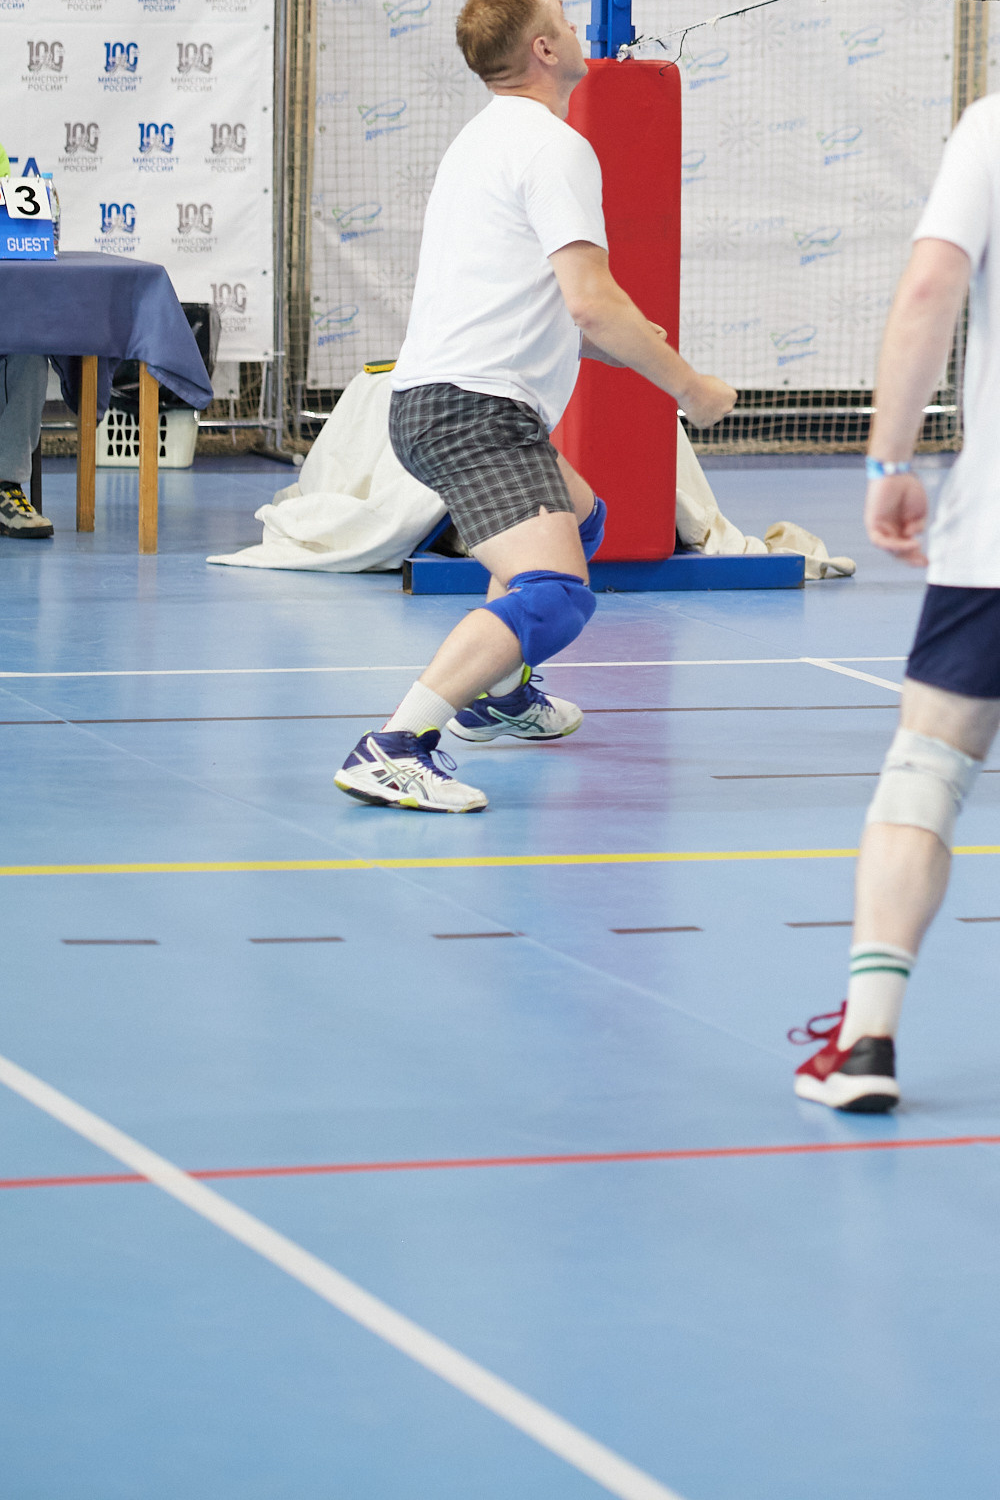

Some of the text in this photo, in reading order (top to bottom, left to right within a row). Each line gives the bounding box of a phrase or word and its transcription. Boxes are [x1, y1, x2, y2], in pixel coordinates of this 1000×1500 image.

[67, 3, 103, 12] РОССИИ
[144, 4, 176, 13] РОССИИ
[211, 4, 247, 13] РОССИИ
[22, 75, 68, 84] МИНСПОРТ
[98, 76, 143, 85] МИНСПОРТ
[171, 76, 217, 86] МИНСПОРТ
[28, 83, 63, 92] РОССИИ
[104, 84, 138, 93] РОССИИ
[177, 85, 212, 94] РОССИИ
[58, 156, 103, 165] МИНСПОРТ
[132, 156, 179, 166] МИНСПОРТ
[205, 157, 251, 166] МИНСПОРТ
[64, 164, 98, 173] РОССИИ
[138, 165, 174, 174] РОССИИ
[211, 165, 246, 174] РОССИИ
[15, 185, 41, 216] 3
[7, 238, 50, 252] GUEST
[95, 237, 140, 246] МИНСПОРТ
[171, 237, 218, 246] МИНСПОРТ
[101, 245, 135, 254] РОССИИ
[177, 245, 213, 254] РОССИИ
